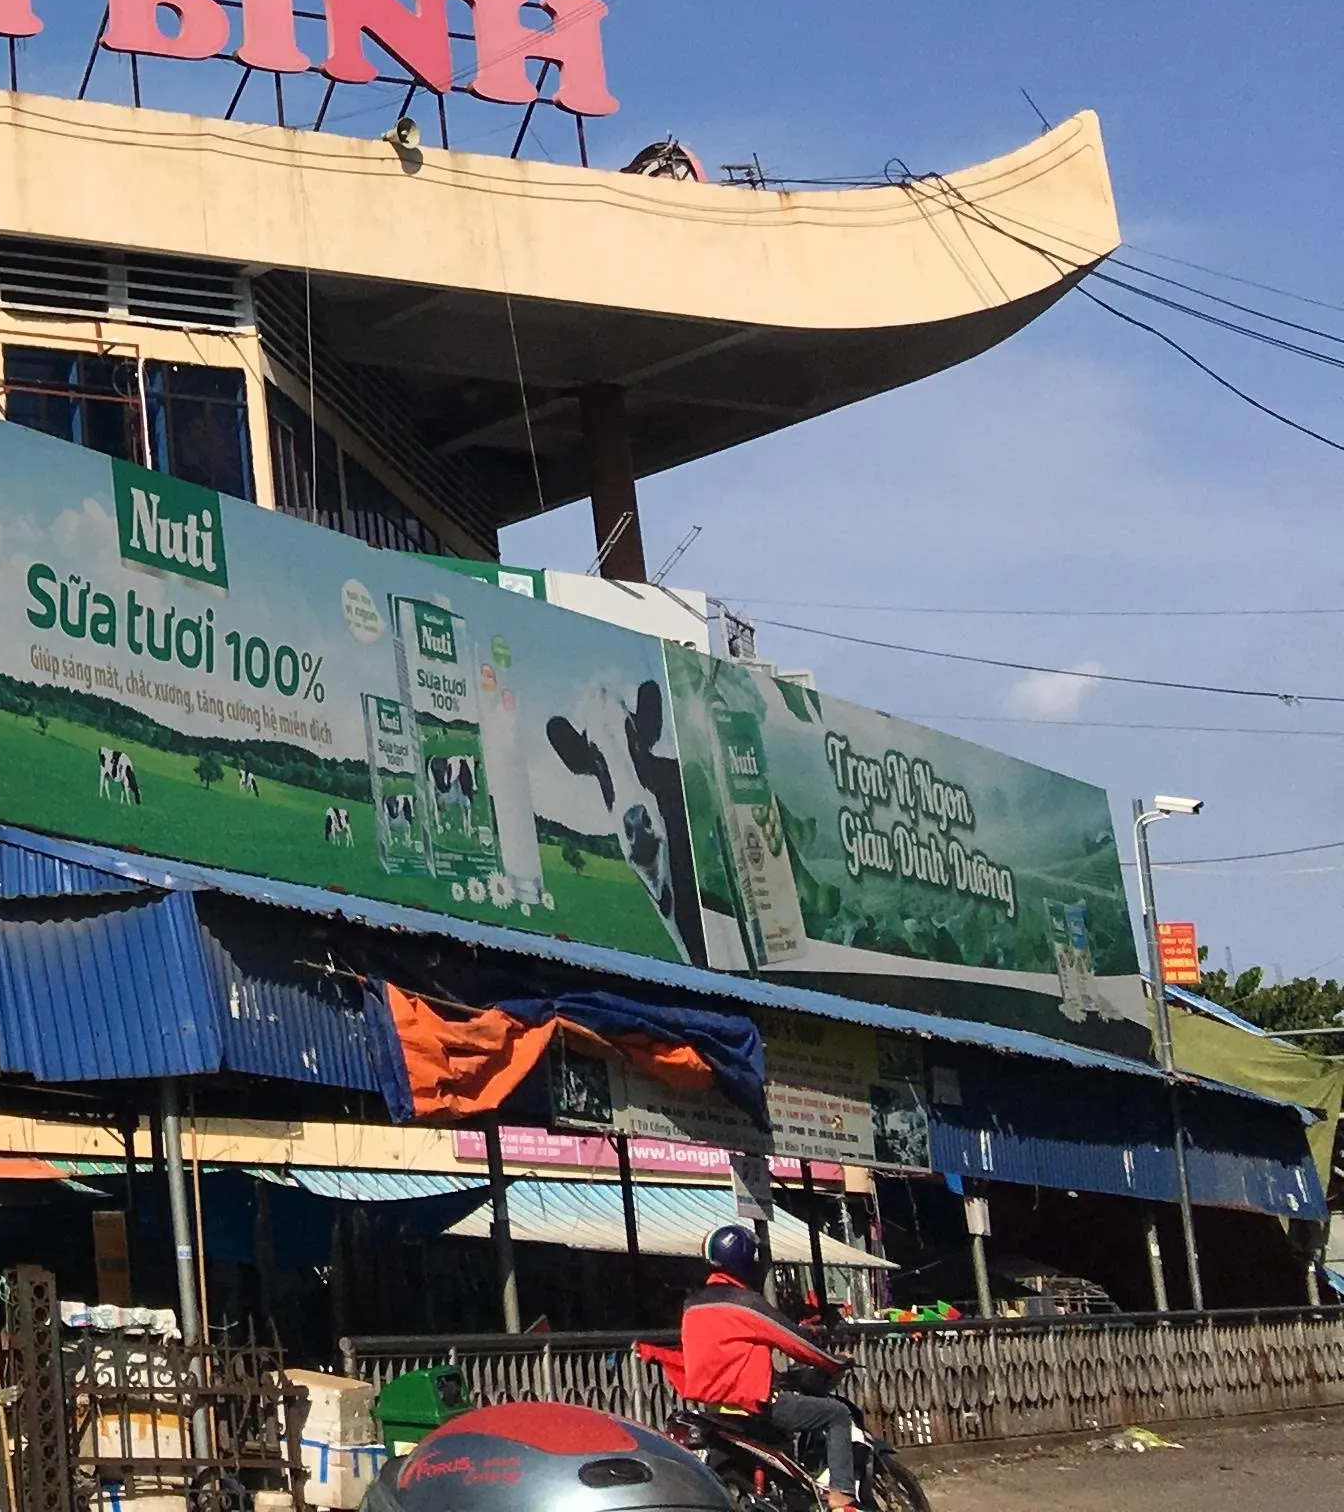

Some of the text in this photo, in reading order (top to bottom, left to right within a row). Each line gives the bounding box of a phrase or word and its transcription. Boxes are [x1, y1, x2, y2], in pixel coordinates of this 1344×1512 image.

[129, 486, 217, 572] Nuti
[25, 562, 326, 704] Sữa tươi 100%
[421, 625, 453, 656] Nuti
[29, 643, 61, 680] Giúp
[62, 654, 93, 689] sáng
[154, 682, 196, 715] xương,
[196, 688, 225, 724] tăng
[226, 697, 262, 732] cường
[262, 704, 279, 737] hệ
[728, 744, 759, 776] Nuti
[825, 734, 974, 832] Trọn Vị Ngon
[839, 809, 895, 877] Giàu
[893, 824, 951, 887] Dinh
[948, 840, 1016, 918] Dưỡng
